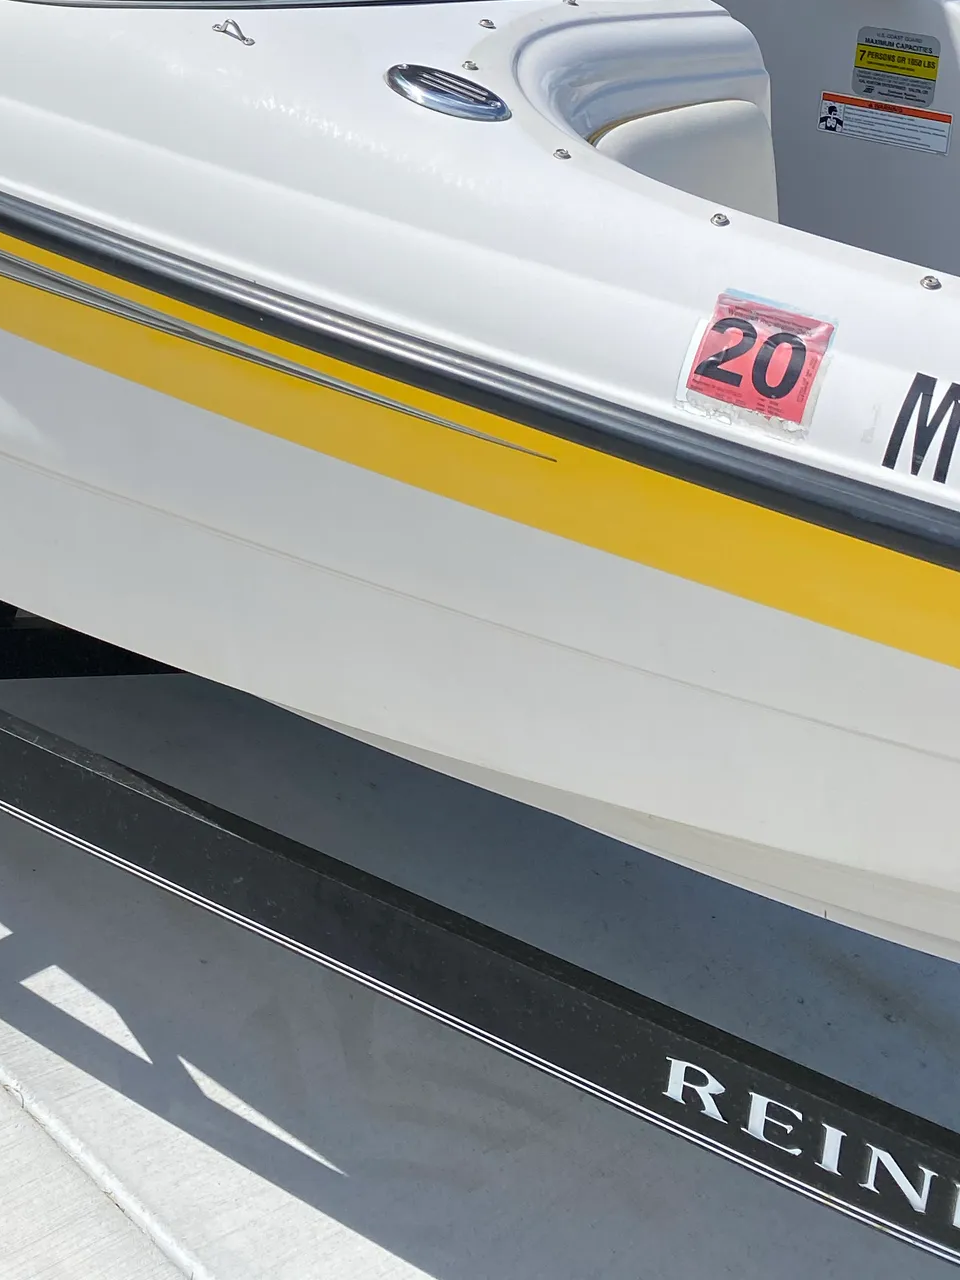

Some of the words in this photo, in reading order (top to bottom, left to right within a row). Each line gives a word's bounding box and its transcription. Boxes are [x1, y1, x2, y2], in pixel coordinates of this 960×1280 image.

[859, 49, 867, 61] 7
[866, 50, 896, 63] PERSONS
[896, 56, 907, 65] OR
[923, 60, 936, 70] LBS
[864, 37, 895, 48] MAXIMUM
[895, 42, 933, 55] CAPACITIES
[693, 317, 807, 400] 20
[661, 1056, 960, 1230] REIN
